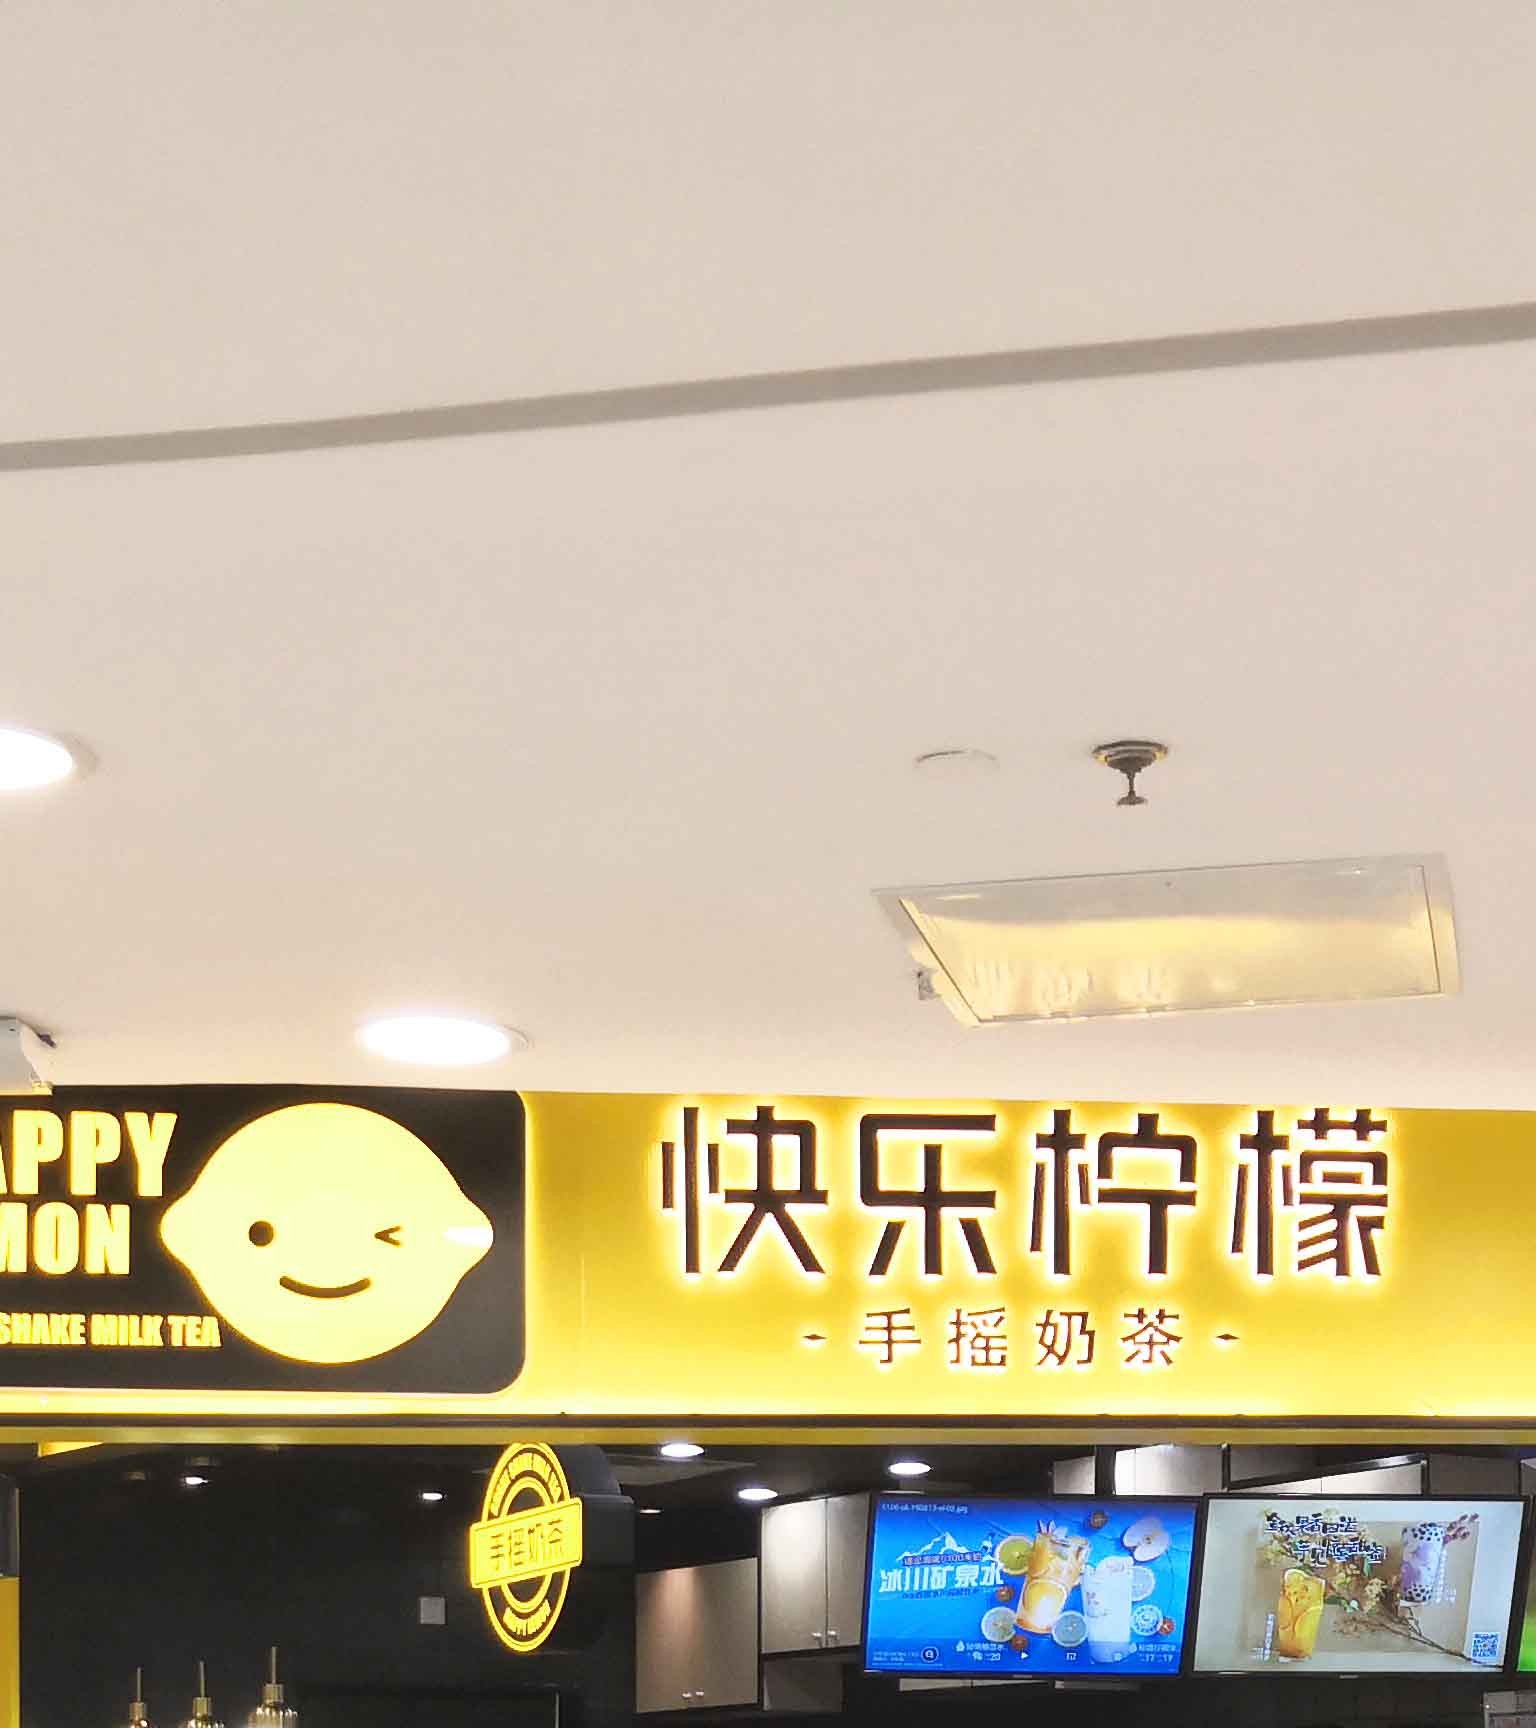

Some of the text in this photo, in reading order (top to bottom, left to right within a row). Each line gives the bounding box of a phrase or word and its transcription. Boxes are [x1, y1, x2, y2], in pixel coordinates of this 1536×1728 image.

[661, 1104, 1390, 1278] 快乐柠檬
[90, 1314, 164, 1347] MILK
[167, 1316, 222, 1348] TEA
[858, 1305, 1185, 1368] 手摇奶茶
[879, 1561, 1004, 1593] 冰川矿泉水
